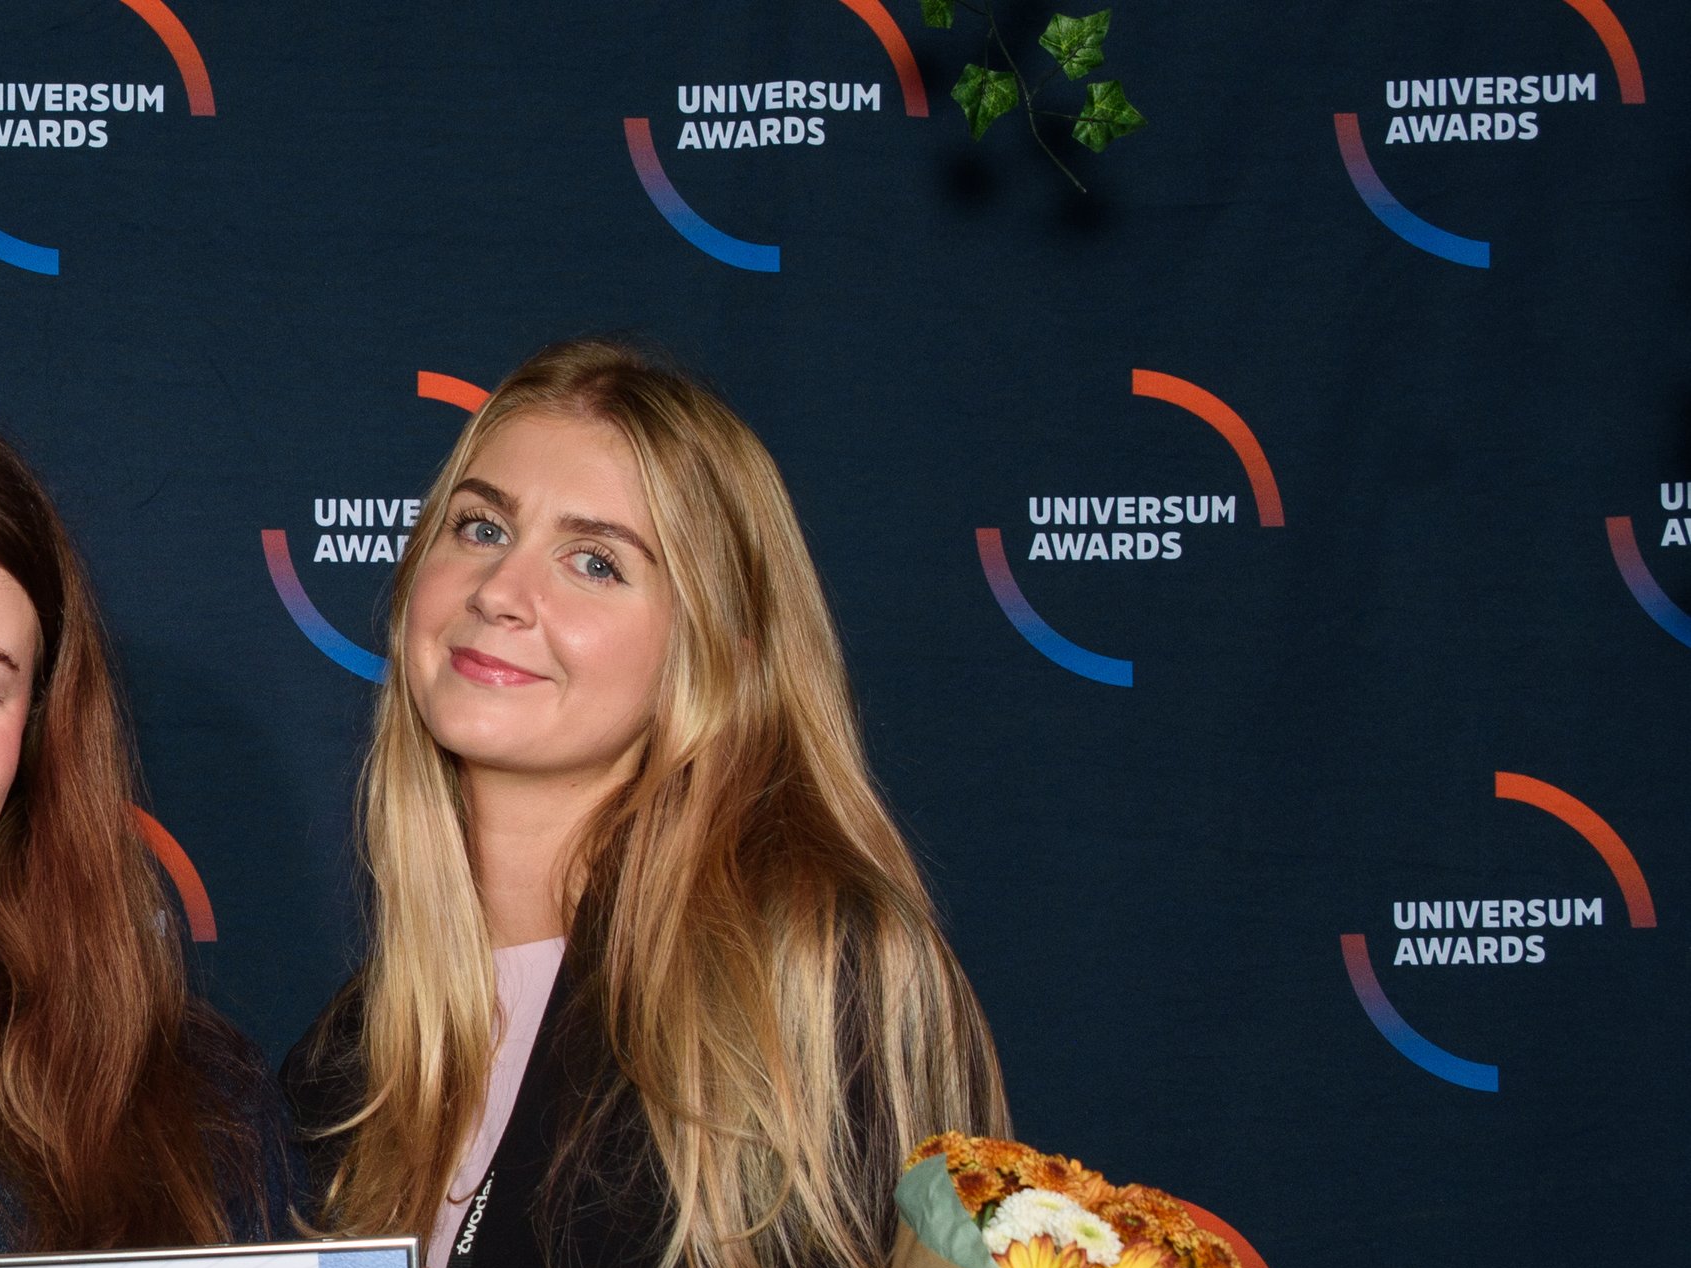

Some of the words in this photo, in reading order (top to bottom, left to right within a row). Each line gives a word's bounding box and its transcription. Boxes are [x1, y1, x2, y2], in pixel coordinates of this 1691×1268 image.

[678, 80, 881, 114] UNIVERSUM
[1386, 73, 1596, 109] UNIVERSUM
[676, 116, 826, 150] AWARDS
[1385, 111, 1539, 145] AWARDS
[1028, 495, 1236, 525] UNIVERSUM
[1028, 531, 1183, 561] AWARDS
[1393, 897, 1603, 930] UNIVERSUM
[1393, 934, 1546, 966] AWARDS
